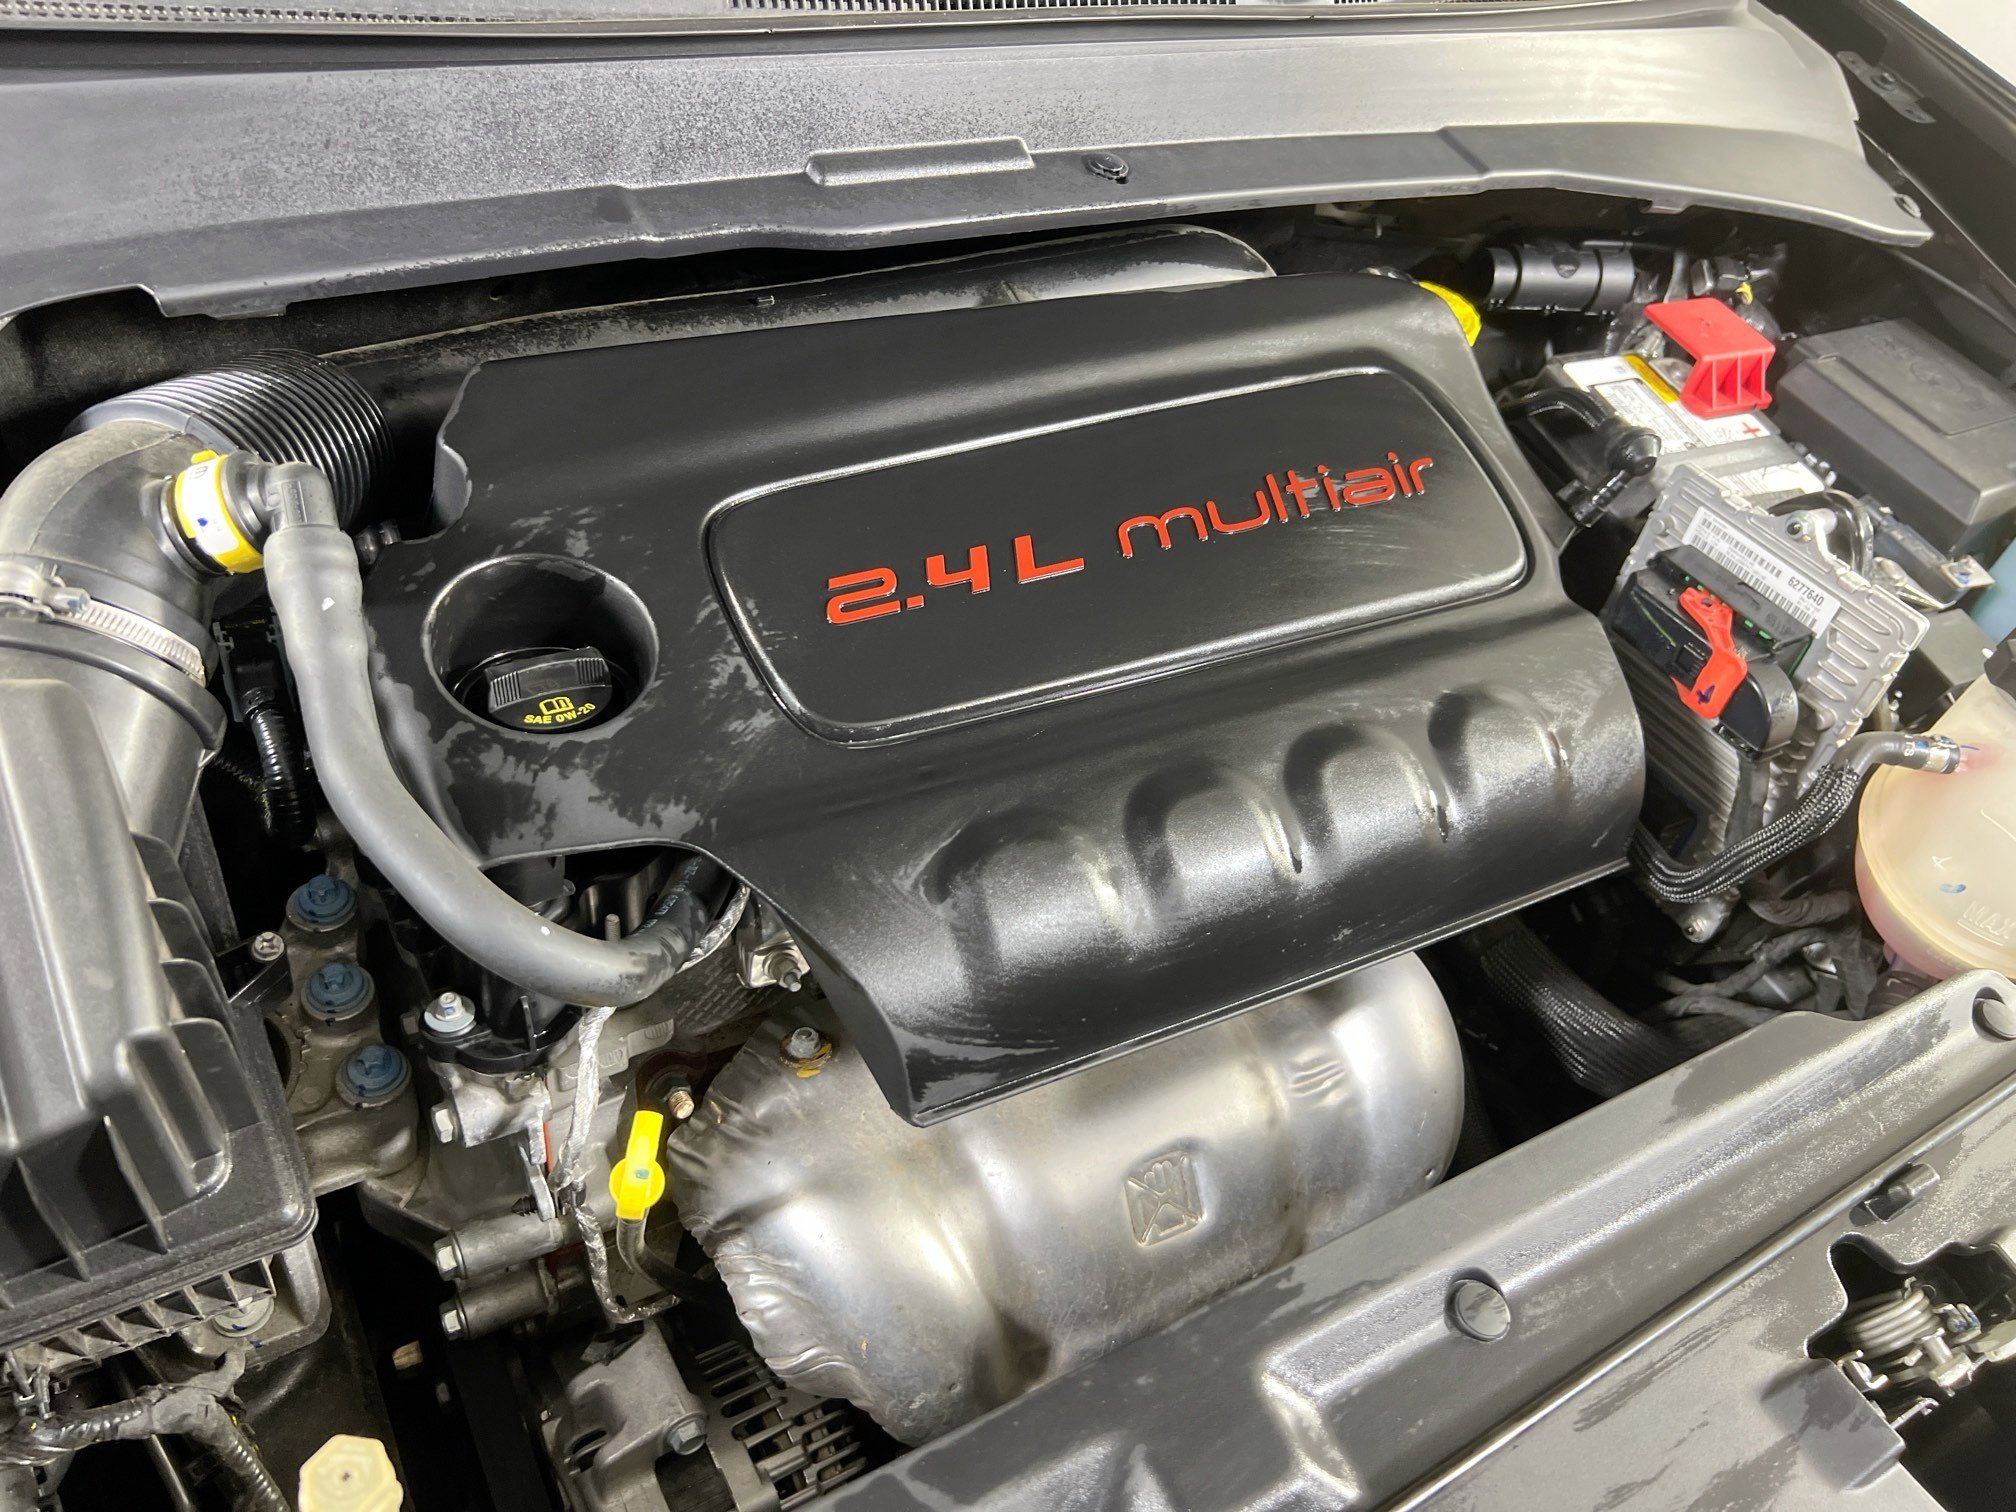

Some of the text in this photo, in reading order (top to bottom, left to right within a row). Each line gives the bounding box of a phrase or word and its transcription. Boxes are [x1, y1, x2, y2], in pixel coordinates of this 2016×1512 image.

[826, 451, 1434, 624] 2.4 L multiair
[1788, 576, 1825, 606] 6277640
[524, 714, 552, 724] SAE
